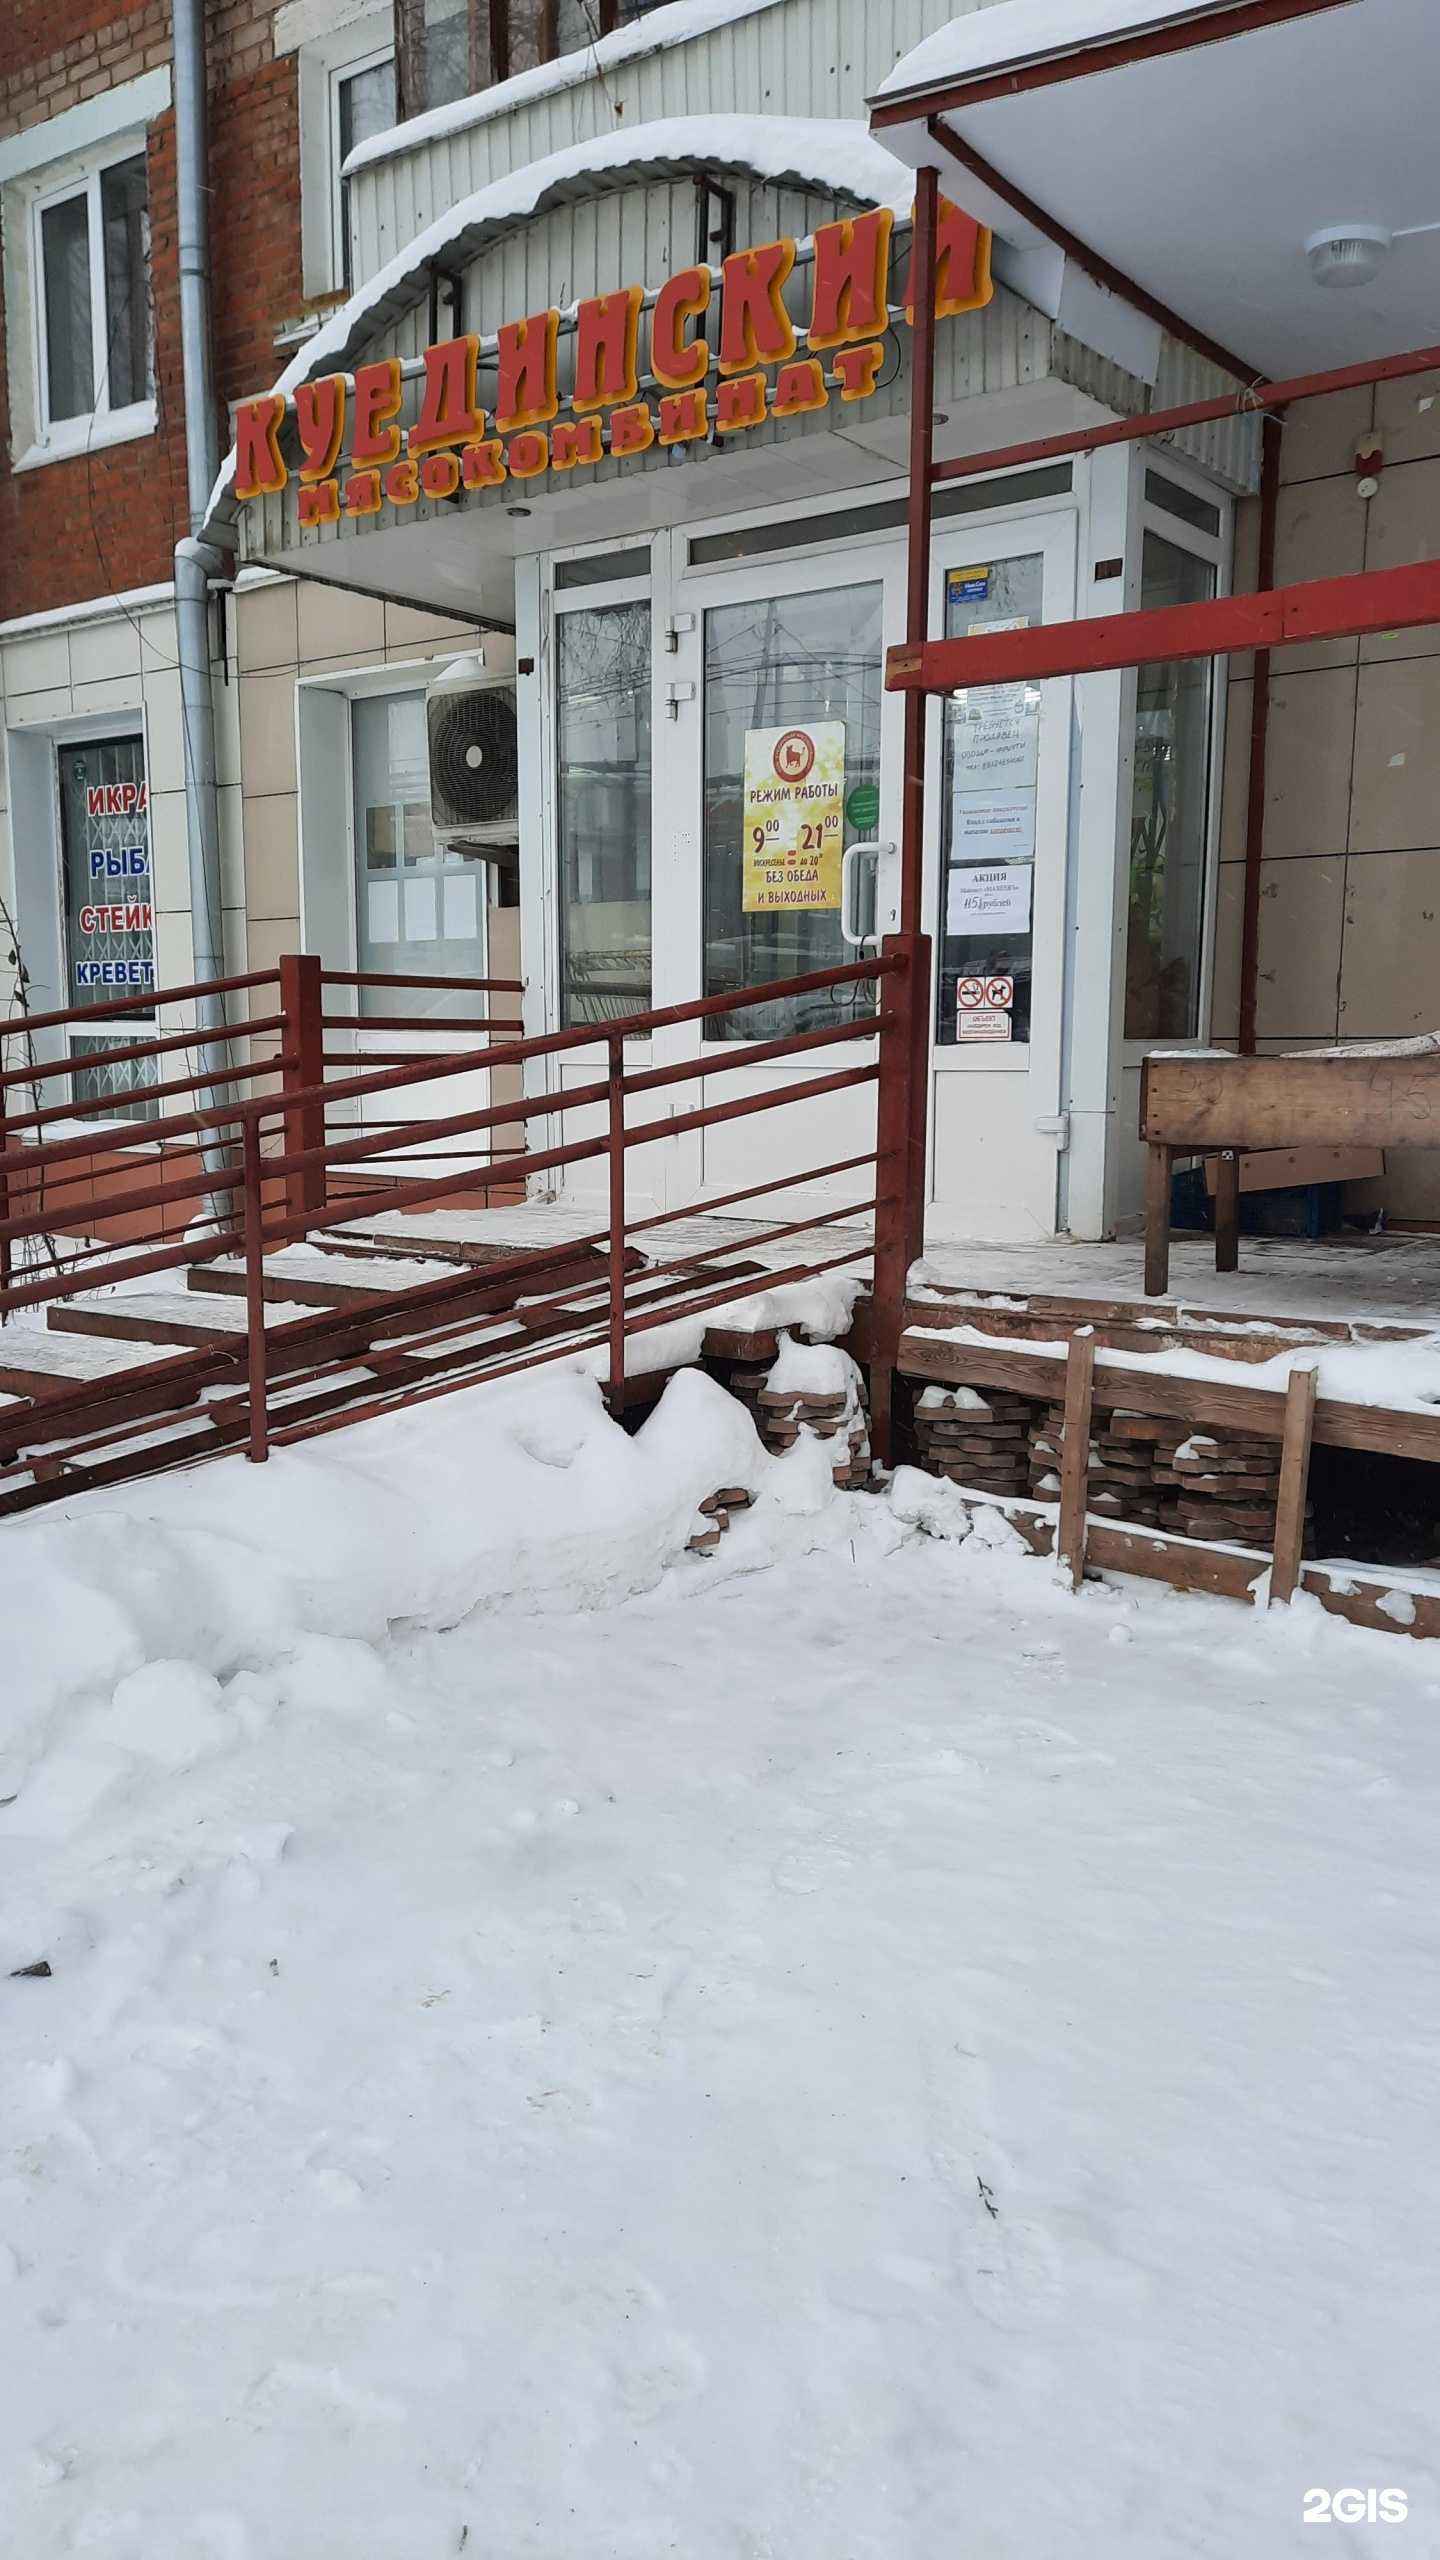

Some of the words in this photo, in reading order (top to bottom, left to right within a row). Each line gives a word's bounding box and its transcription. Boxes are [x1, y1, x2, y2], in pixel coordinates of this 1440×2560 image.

[298, 341, 885, 527] МЯСОКОМБИНАТ
[750, 787, 792, 804] РЕЖИМ
[794, 783, 839, 800] РАБОТЫ
[90, 846, 150, 880] РЫБ
[766, 870, 784, 883] БЕЗ
[786, 869, 819, 882] ОБЕДА
[971, 872, 1007, 883] АКЦИЯ
[757, 893, 765, 904] И
[768, 888, 827, 904] ВЫХОДНЫХ
